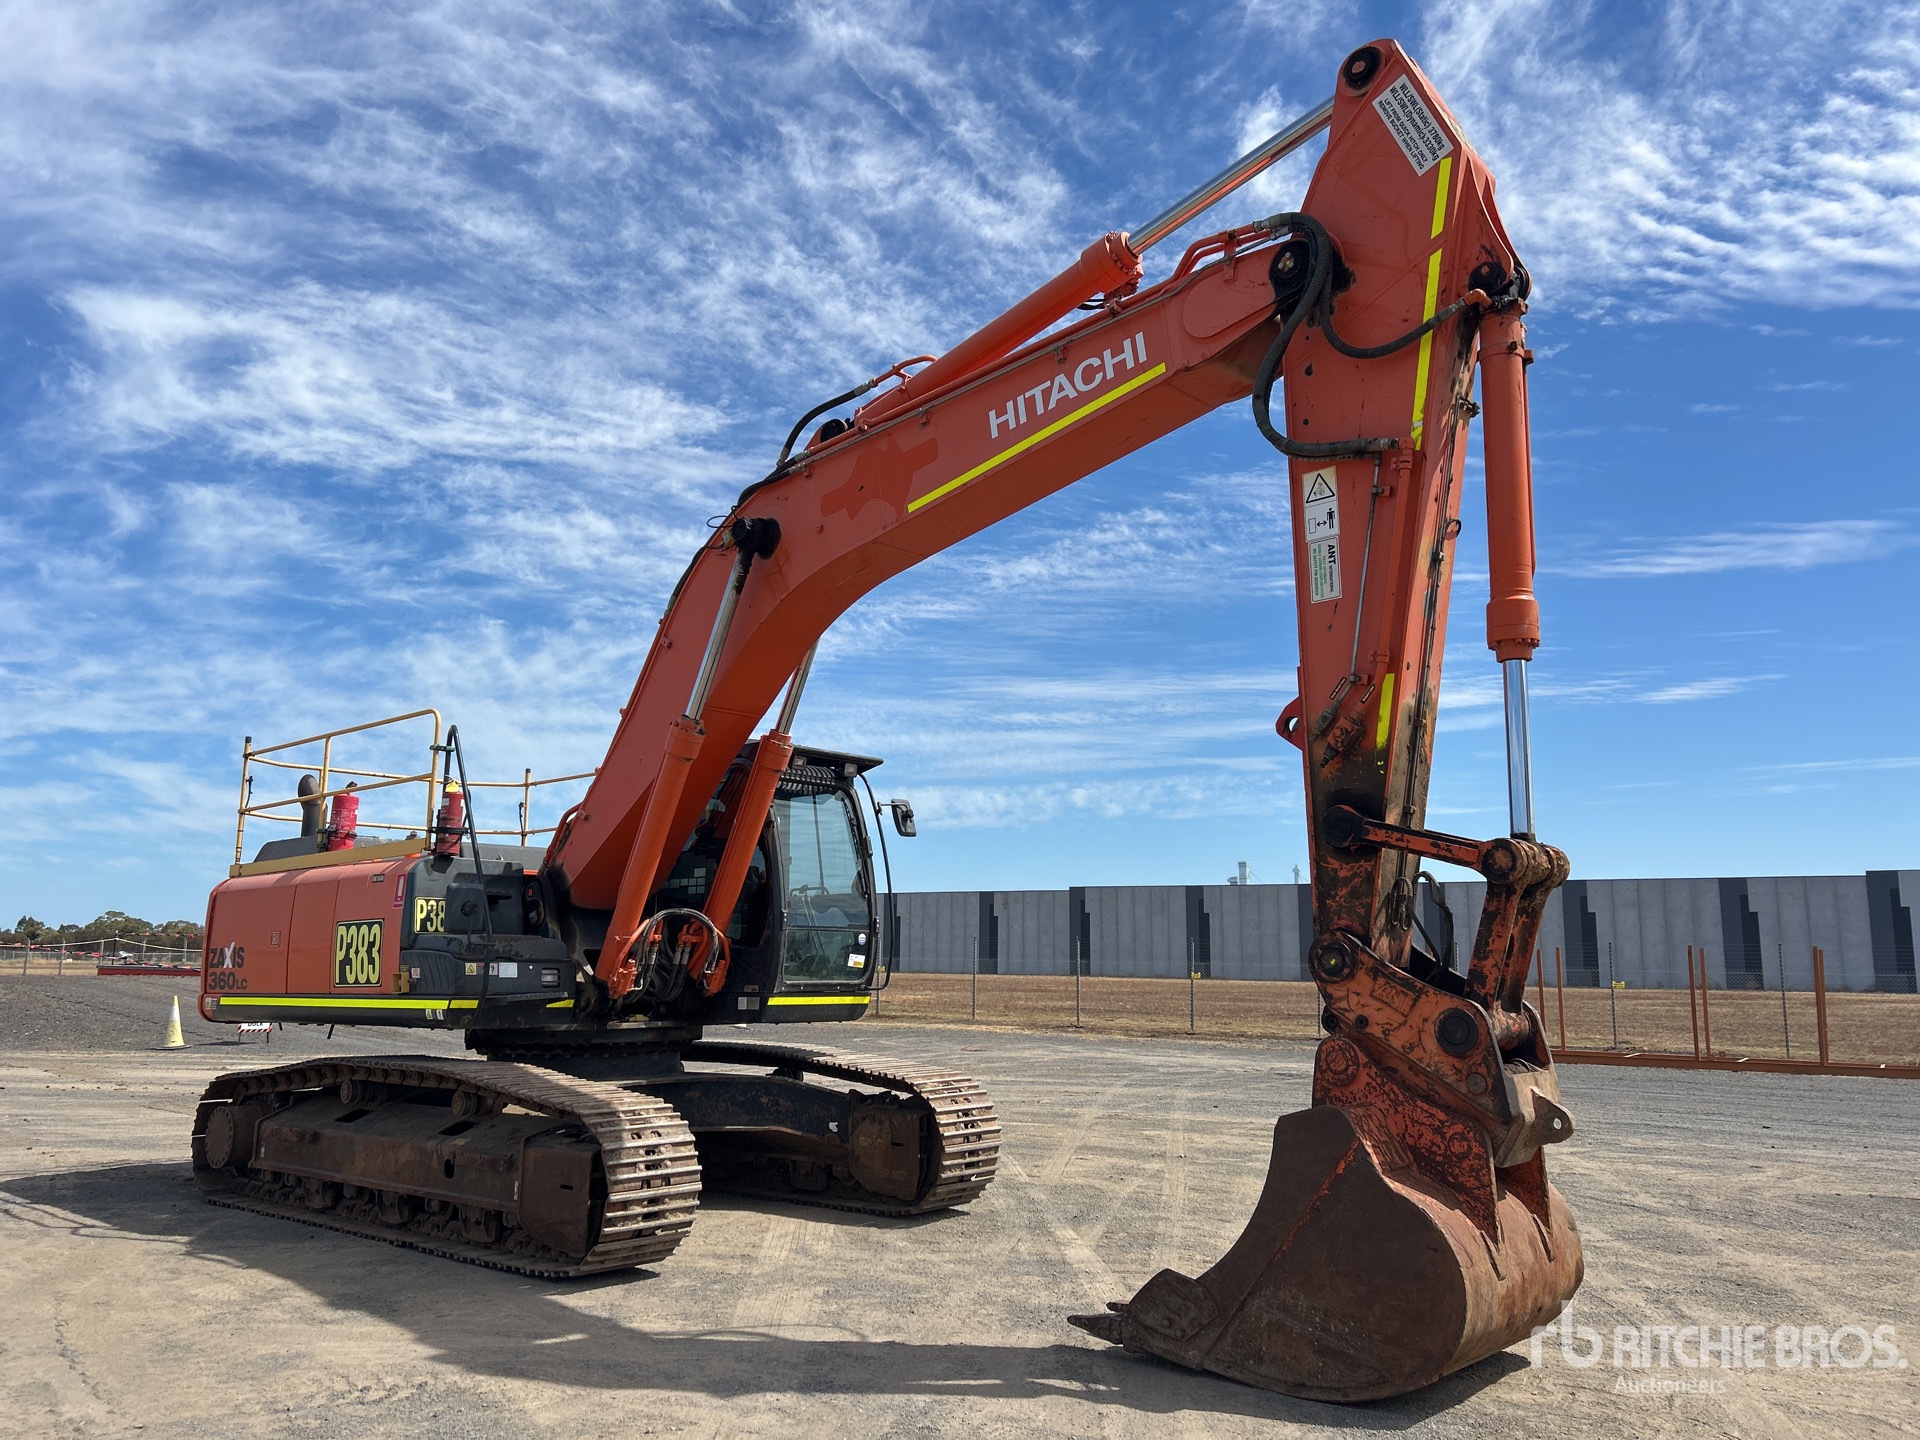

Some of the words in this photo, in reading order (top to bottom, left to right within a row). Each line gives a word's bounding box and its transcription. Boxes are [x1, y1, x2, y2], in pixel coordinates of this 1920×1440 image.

[1378, 100, 1393, 120] REMOVE
[1389, 119, 1404, 138] BUCKET
[1402, 137, 1412, 152] WHEN
[1410, 149, 1424, 169] LIFTING
[1384, 98, 1392, 108] LIFT
[1391, 106, 1401, 122] FROM
[1400, 121, 1411, 136] QUICK
[1409, 135, 1420, 151] HITCH
[1418, 149, 1428, 163] ONLY
[1399, 82, 1431, 130] WLL/SWL(Static)
[1428, 126, 1445, 151] 3780kg
[988, 332, 1148, 439] HITACHI
[1328, 544, 1336, 564] ANT
[416, 899, 446, 932] P38
[209, 942, 245, 969] ZAXIS
[336, 924, 381, 984] P383
